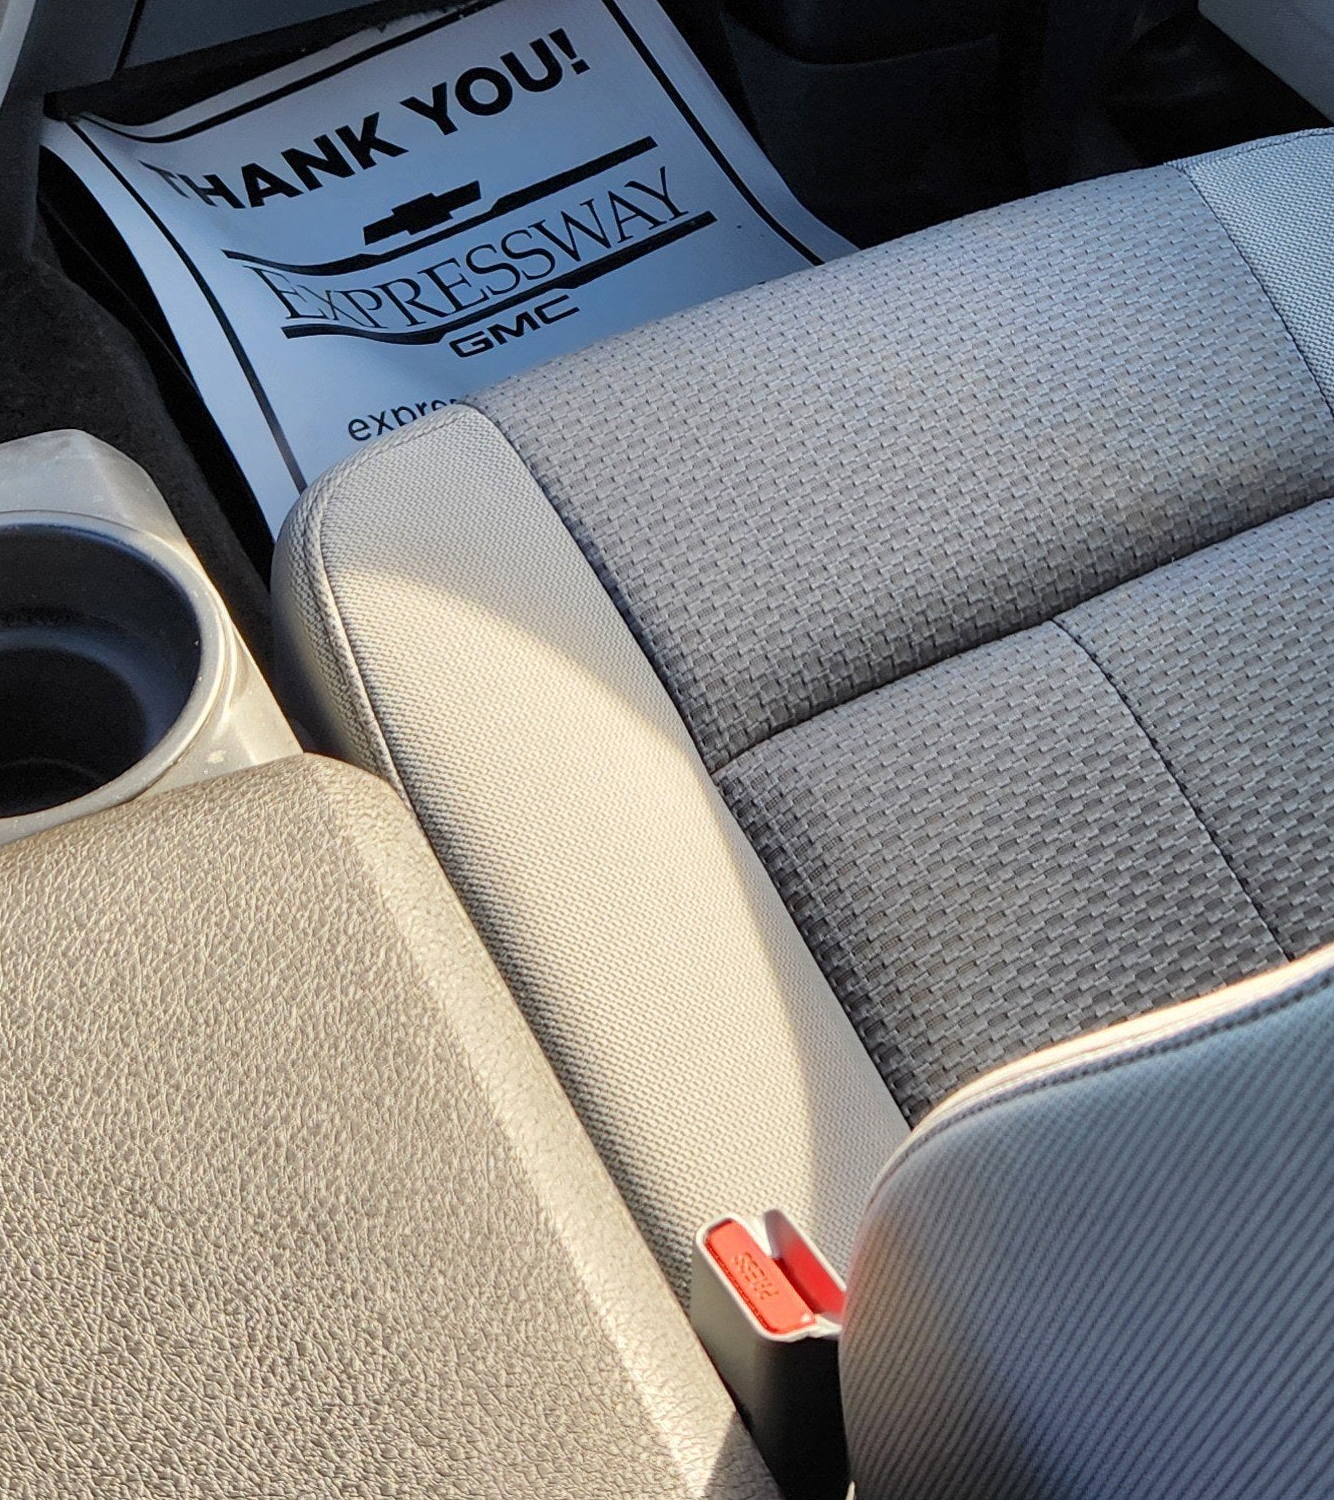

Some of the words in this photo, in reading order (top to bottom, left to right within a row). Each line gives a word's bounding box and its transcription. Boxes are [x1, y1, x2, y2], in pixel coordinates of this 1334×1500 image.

[141, 111, 409, 210] THANK
[399, 28, 591, 137] YOU!
[244, 165, 693, 331] EXPRESSWAY
[448, 293, 581, 358] GMC
[348, 398, 461, 442] expr
